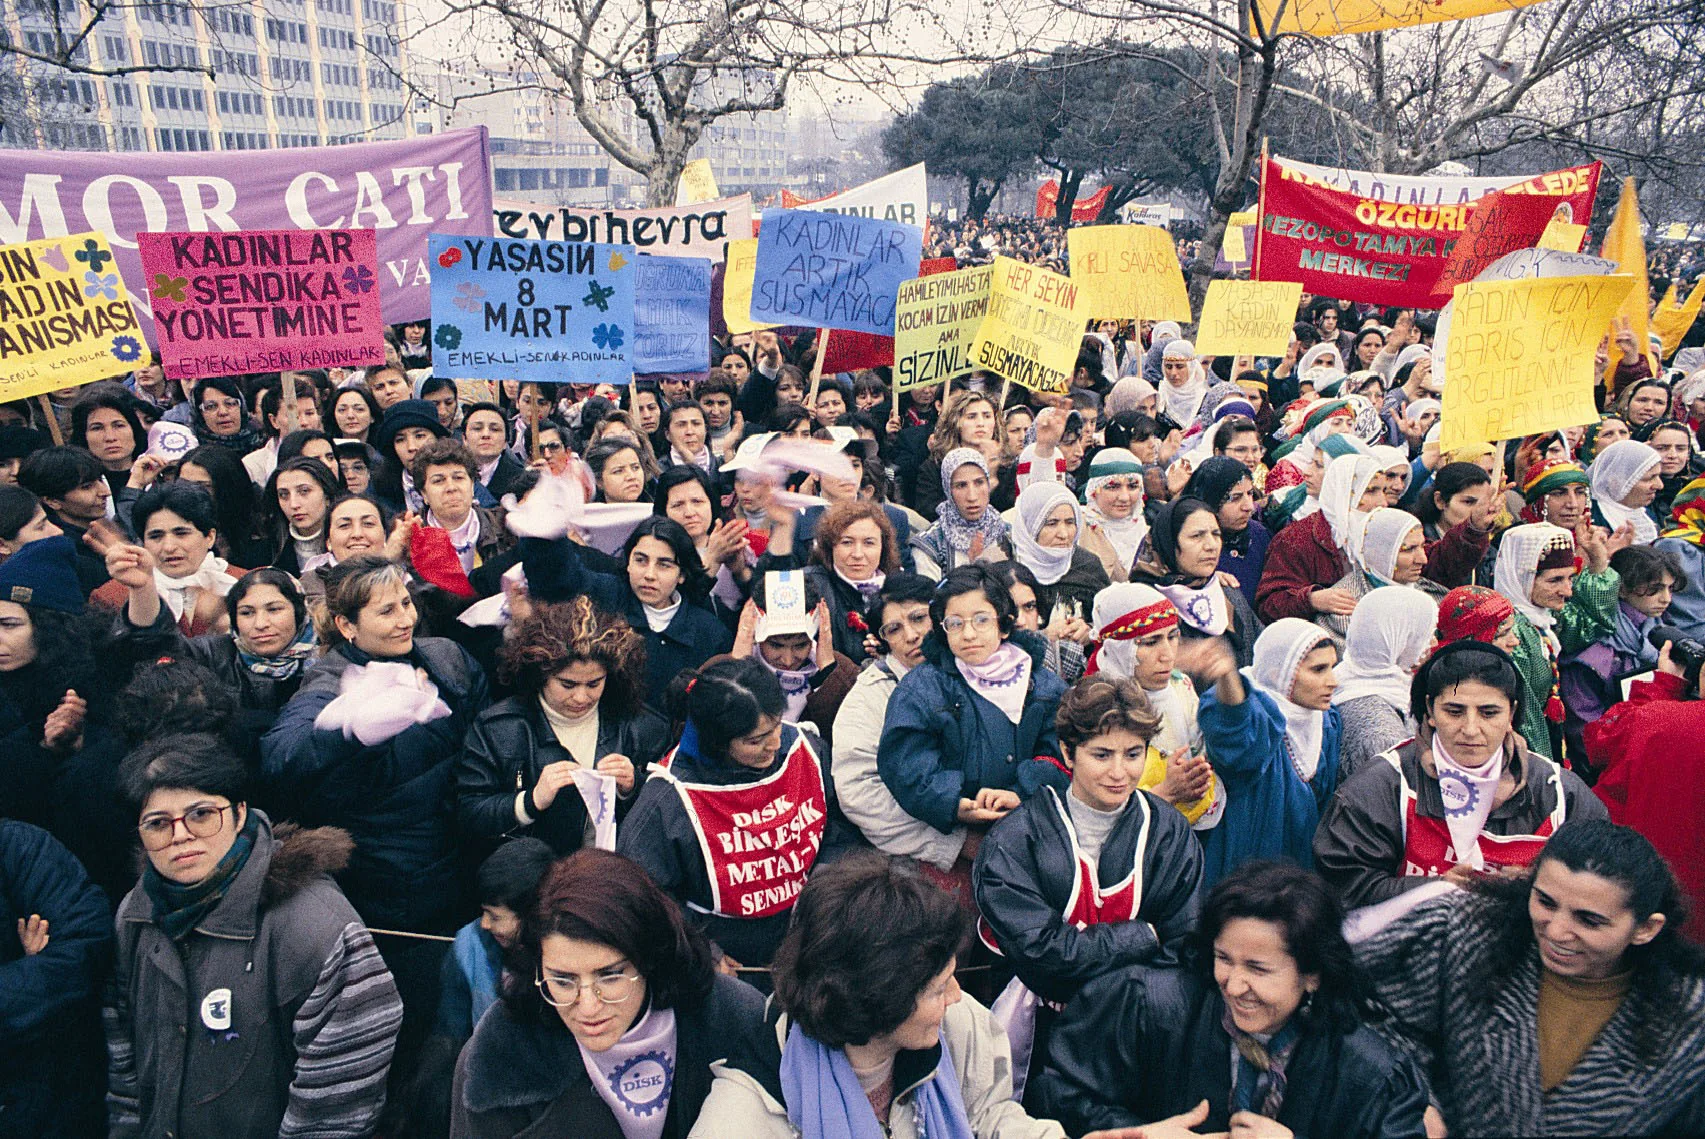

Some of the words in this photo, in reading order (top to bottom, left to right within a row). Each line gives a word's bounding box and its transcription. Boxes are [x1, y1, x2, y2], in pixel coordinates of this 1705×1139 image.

[603, 210, 728, 246] hevra
[776, 216, 906, 264] KADINLAR
[171, 232, 355, 270] KADINLAR
[464, 239, 595, 276] YAŞASIN
[192, 266, 342, 306] SENDİKA
[781, 253, 873, 294] ARTIK
[1005, 263, 1033, 294] HER
[517, 278, 535, 307] 8
[484, 301, 573, 340] MART
[899, 306, 933, 333] KOCAM
[937, 328, 960, 345] AMA
[179, 351, 292, 376] EMEKLİ-SEN
[300, 346, 380, 368] KADINLAR
[731, 794, 794, 828] DİSK
[623, 1072, 662, 1092] DİSK
